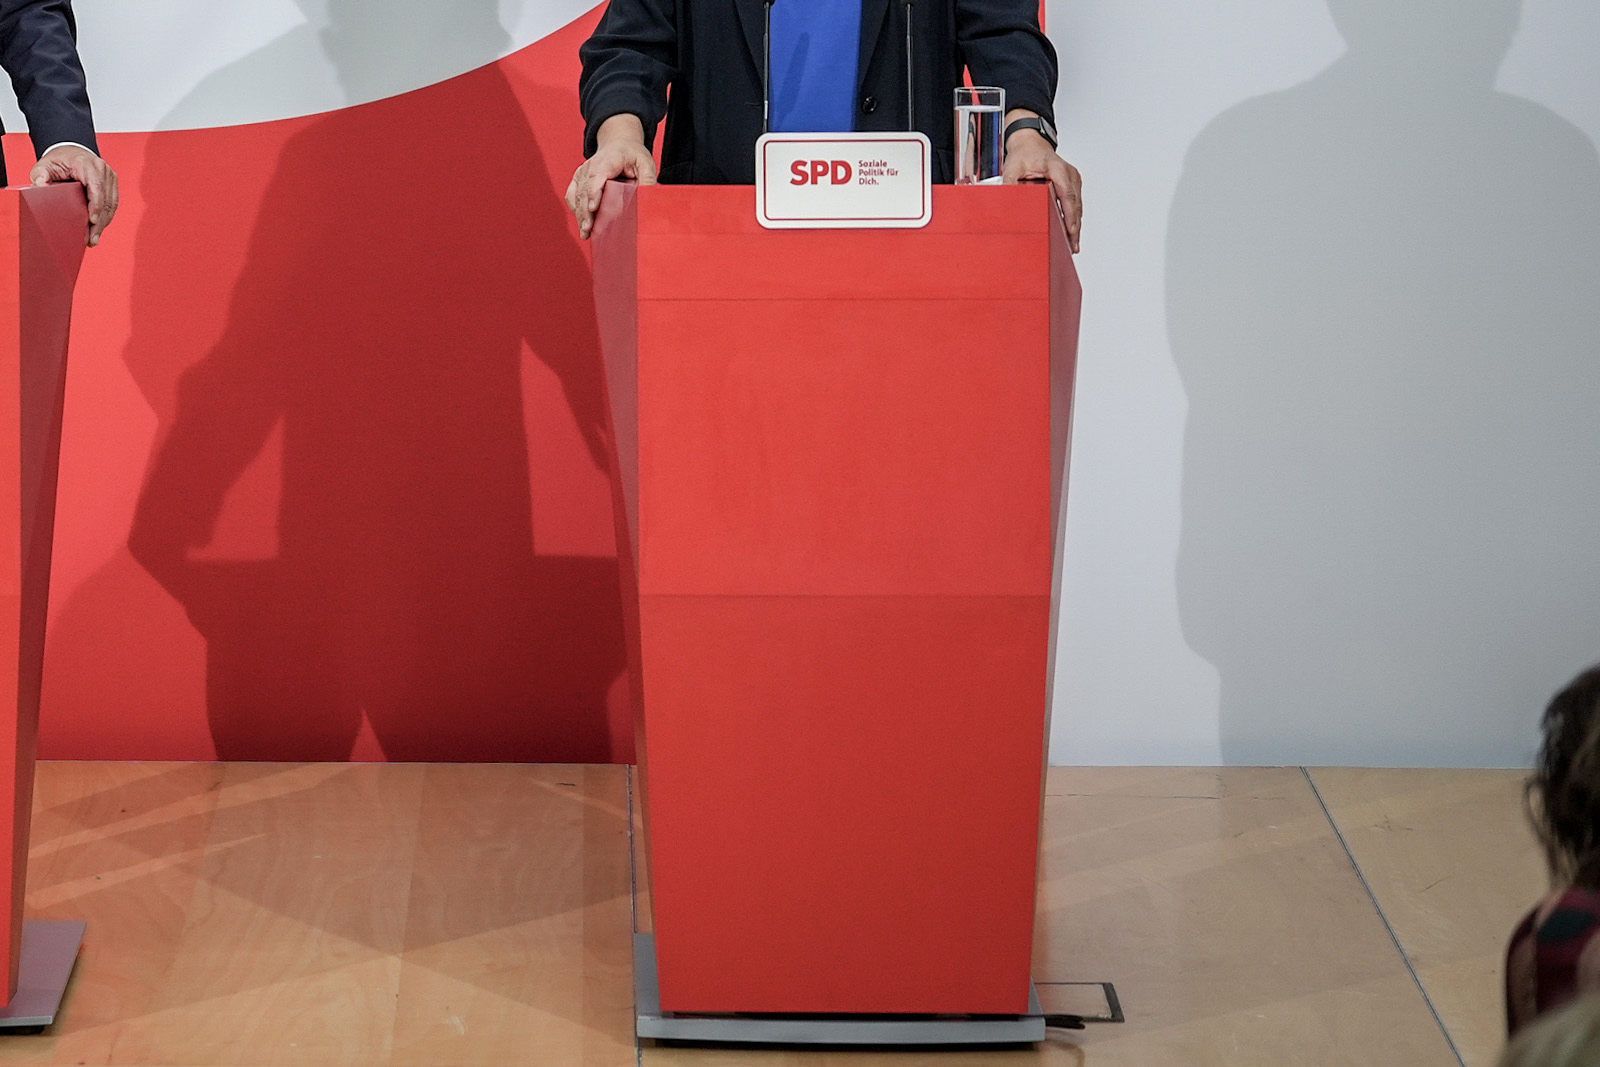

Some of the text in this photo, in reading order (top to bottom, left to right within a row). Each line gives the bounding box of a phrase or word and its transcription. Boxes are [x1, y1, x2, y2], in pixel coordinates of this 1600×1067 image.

[858, 160, 888, 168] Soziale
[789, 159, 853, 186] SPD
[858, 168, 899, 176] Politik für
